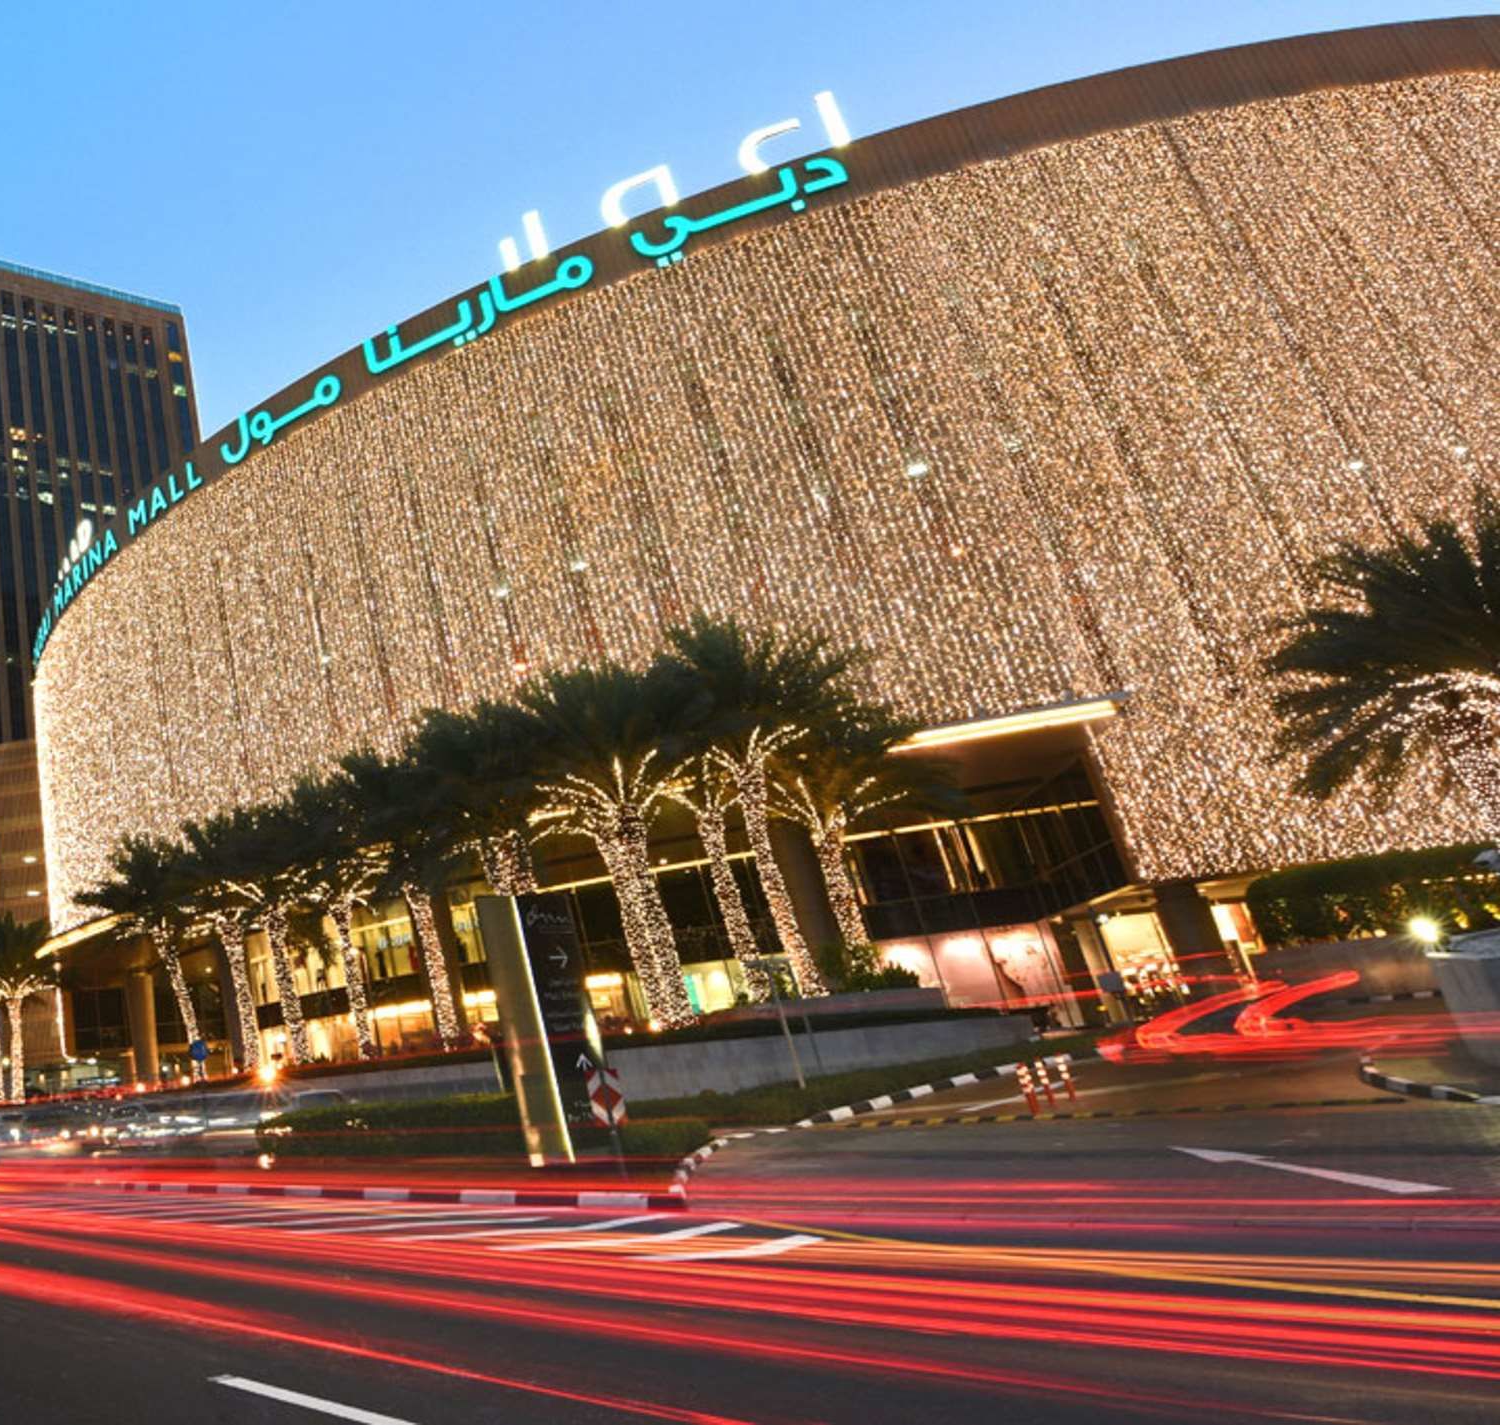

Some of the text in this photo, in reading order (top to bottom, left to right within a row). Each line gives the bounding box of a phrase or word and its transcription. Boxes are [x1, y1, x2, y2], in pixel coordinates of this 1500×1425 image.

[220, 156, 848, 464] دبي مارينا مول
[54, 529, 118, 617] MARINA
[128, 462, 203, 536] MALL
